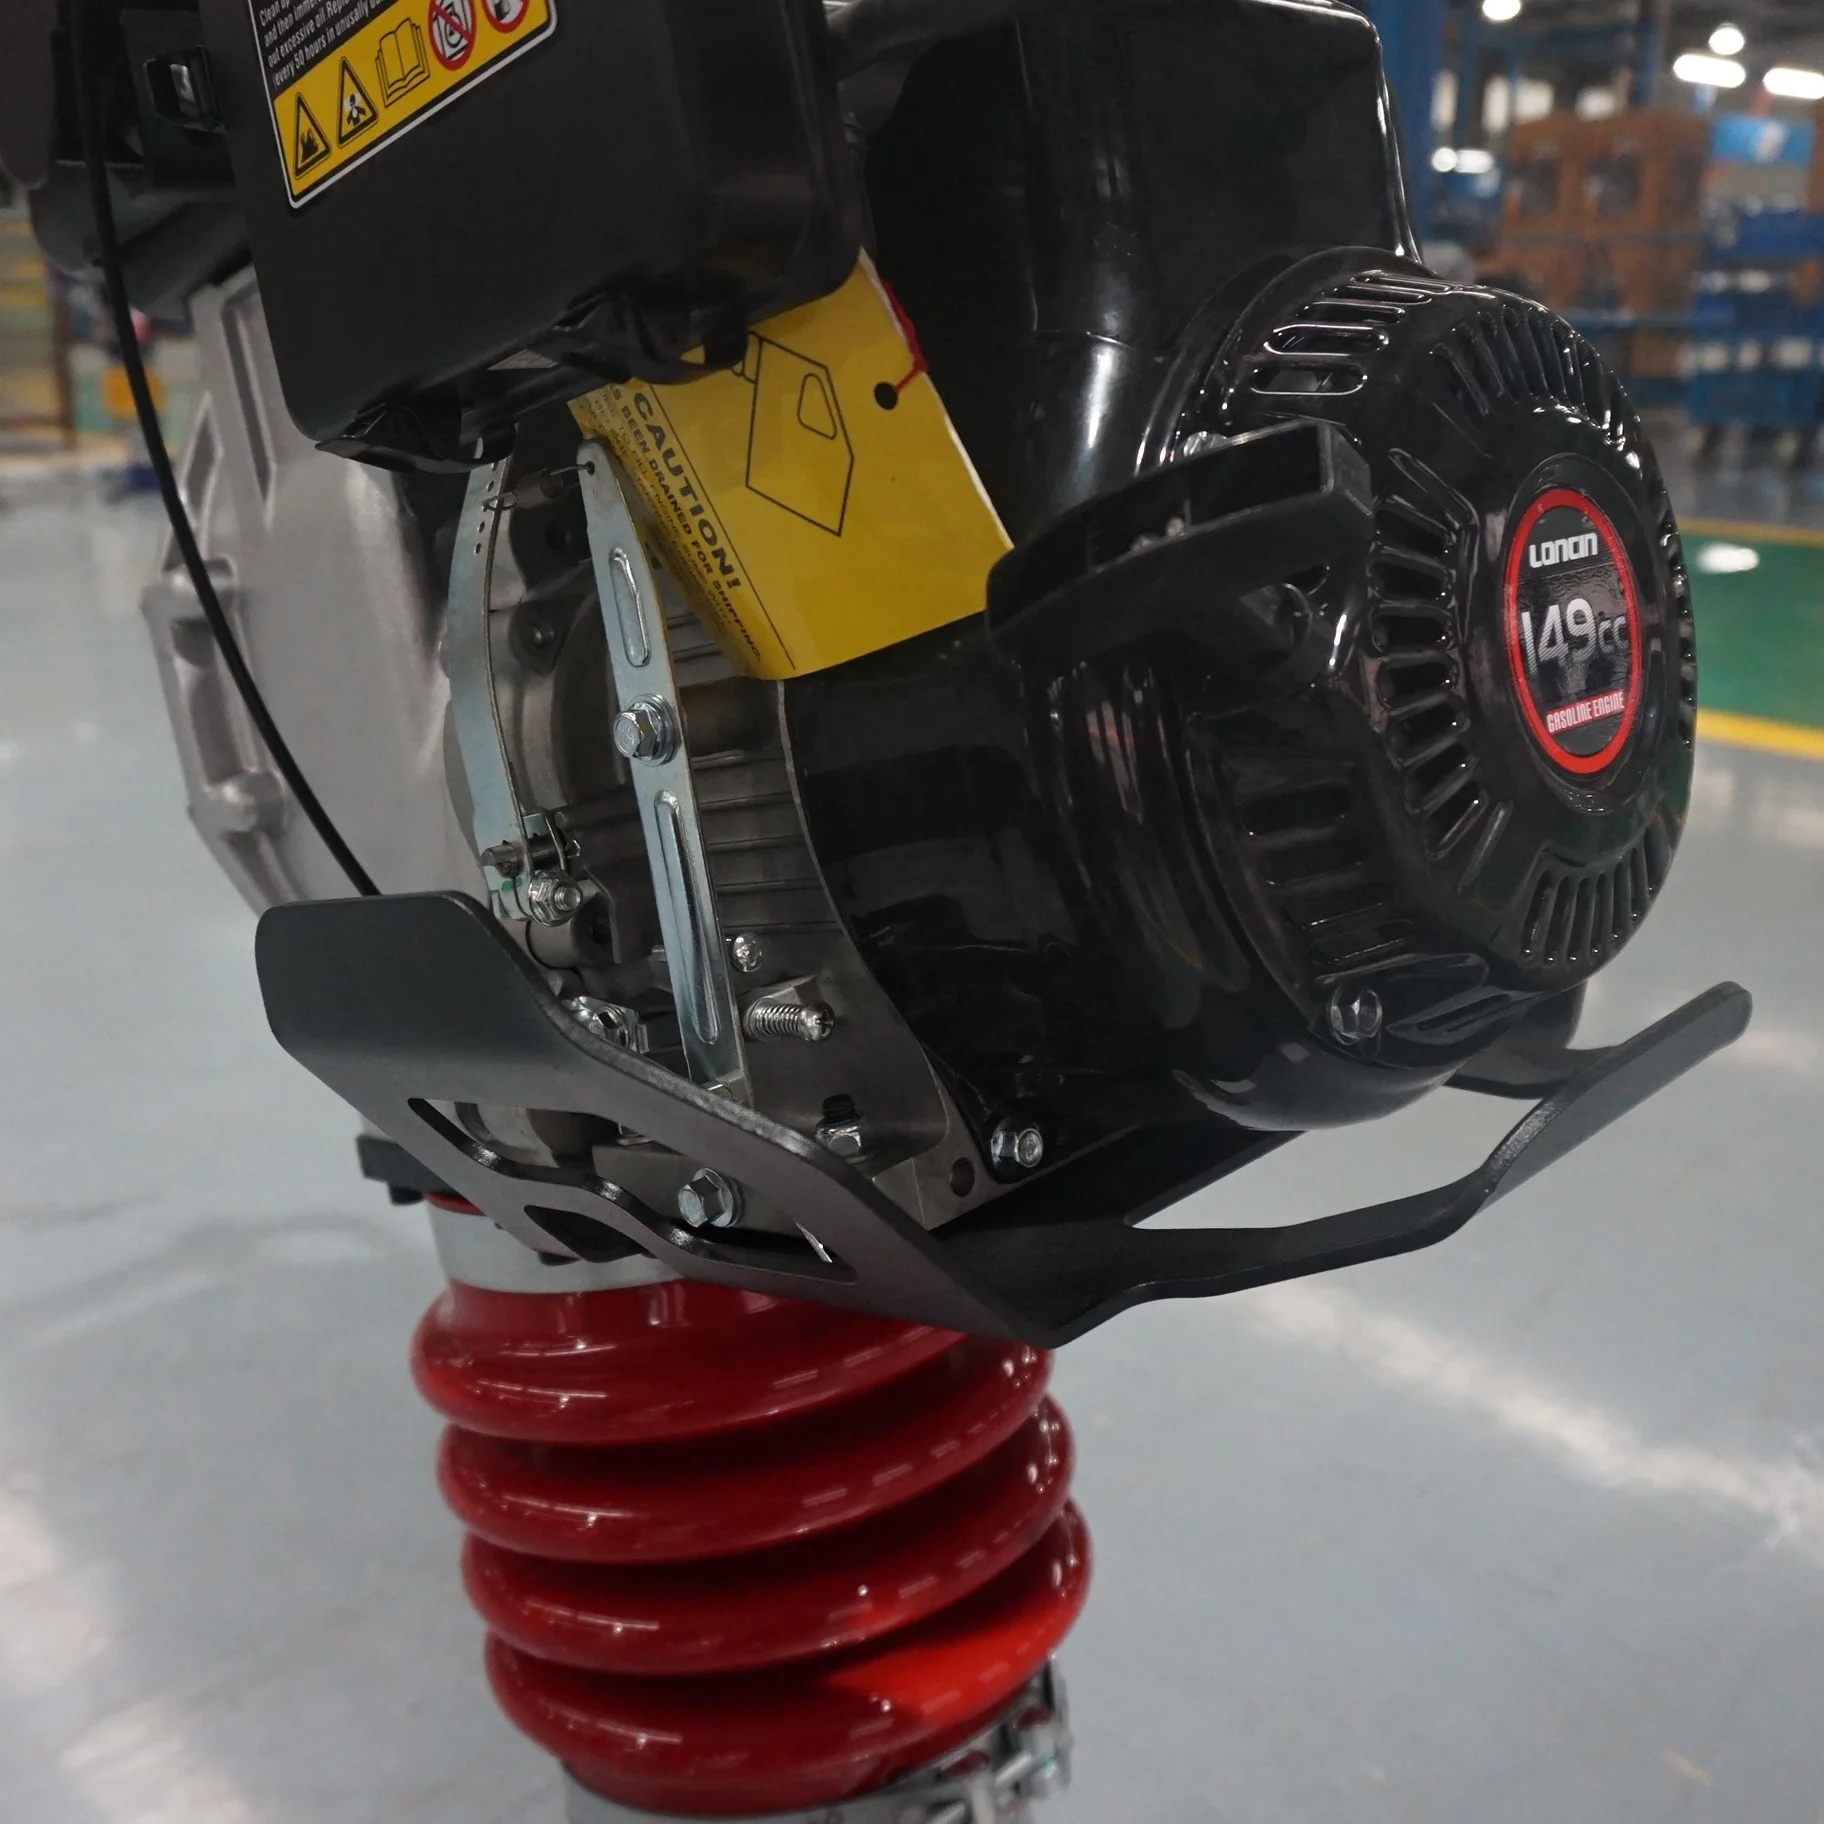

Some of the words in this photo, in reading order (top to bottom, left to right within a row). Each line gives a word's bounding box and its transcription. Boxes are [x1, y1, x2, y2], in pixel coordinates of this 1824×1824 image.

[260, 0, 280, 27] Clean
[264, 23, 278, 48] and
[276, 12, 294, 36] then
[293, 0, 318, 21] imme
[268, 46, 281, 68] out
[280, 20, 315, 58] excessive
[315, 6, 326, 28] oil
[272, 61, 295, 92] (every
[294, 49, 304, 70] 50
[304, 35, 327, 61] hours
[326, 27, 336, 44] in
[335, 0, 370, 37] unusally
[634, 392, 741, 589] CAUTION!
[622, 405, 650, 454] BEEN
[648, 458, 692, 535] DRAINED
[691, 539, 714, 576] FOR
[712, 578, 761, 662] SHIPPING.
[1546, 702, 1593, 733] GASOLINE
[1592, 691, 1625, 718] ENGINE
